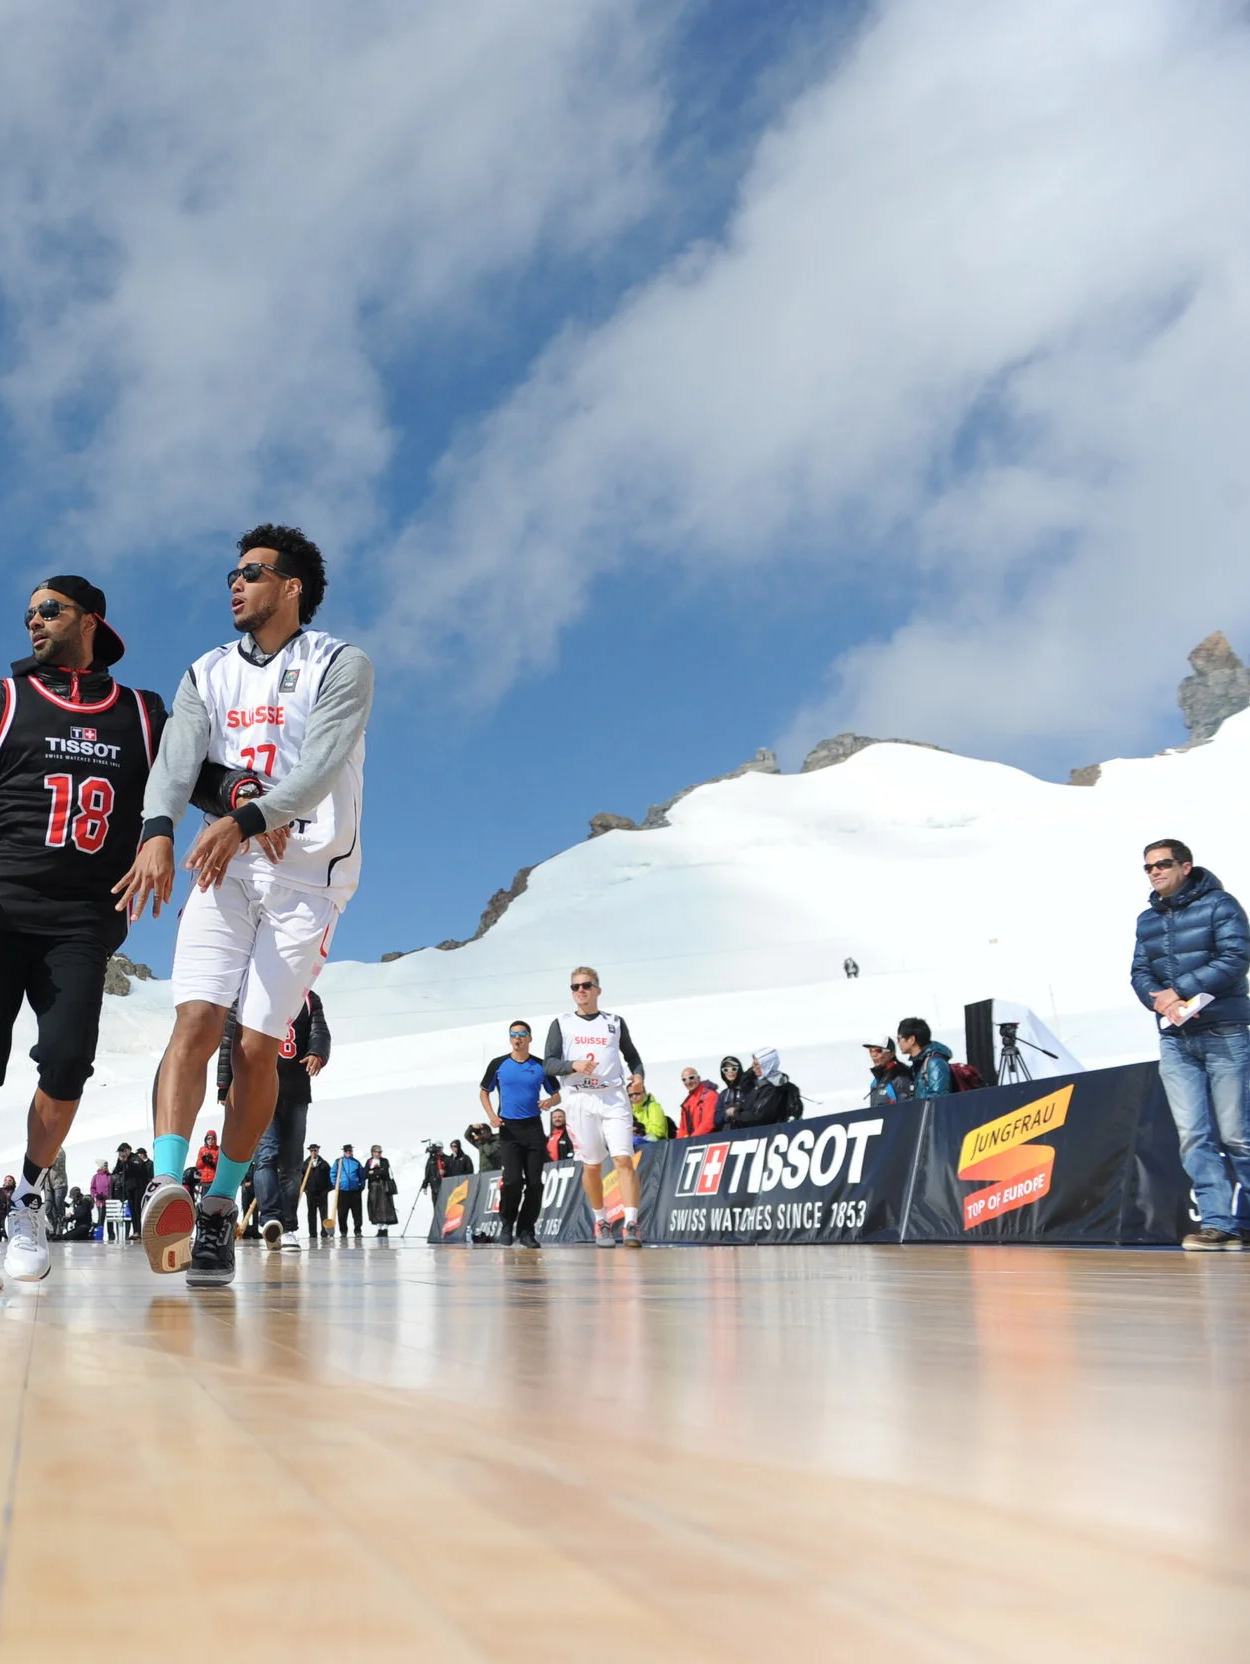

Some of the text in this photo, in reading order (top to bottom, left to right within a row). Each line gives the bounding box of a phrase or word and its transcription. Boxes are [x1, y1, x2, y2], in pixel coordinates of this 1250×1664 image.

[45, 737, 120, 759] TISSOT
[65, 755, 91, 763] WATCHES
[44, 773, 115, 854] 18
[970, 1102, 1056, 1161] JUNGFRAU
[728, 1118, 884, 1194] TISSOT
[669, 1200, 867, 1231] SWISS WATCHES SINCE 1853
[967, 1173, 1046, 1219] TOP OF EUROPE
